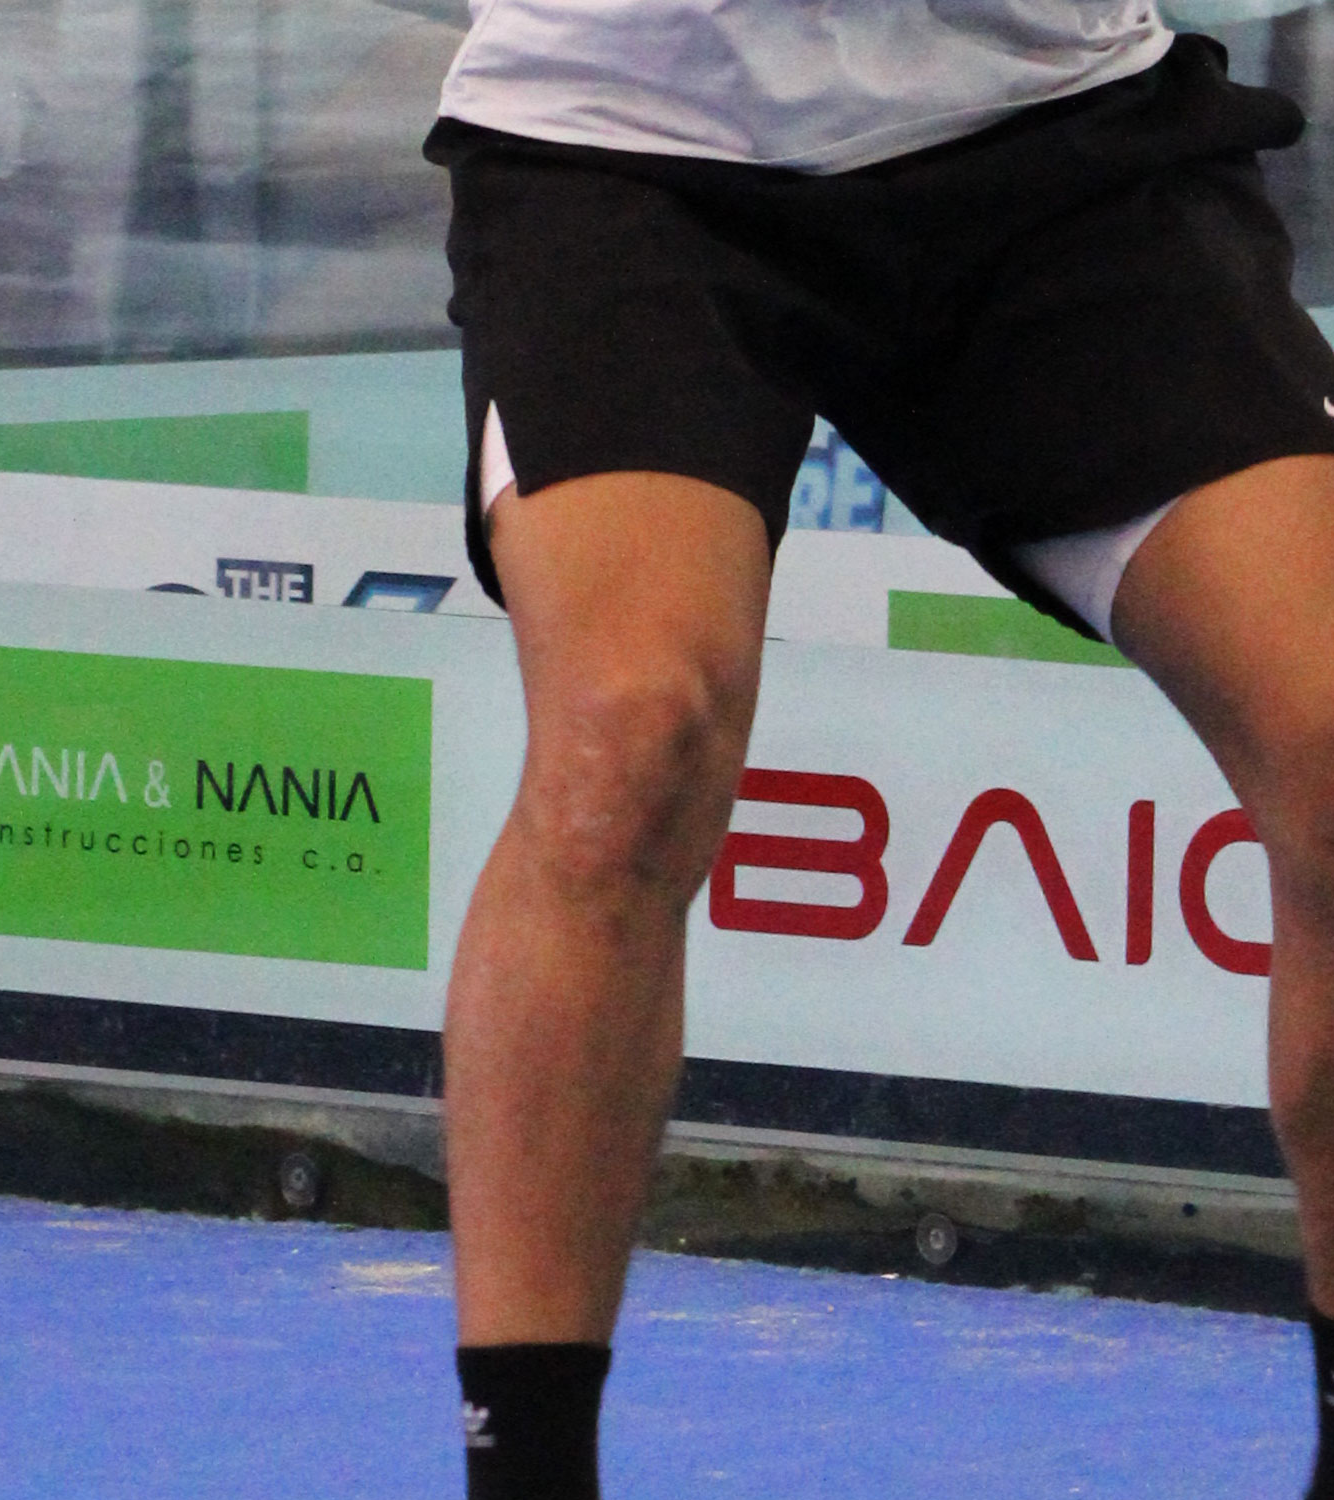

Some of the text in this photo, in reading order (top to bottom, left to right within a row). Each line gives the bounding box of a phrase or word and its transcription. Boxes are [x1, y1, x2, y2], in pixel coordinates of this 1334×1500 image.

[143, 759, 172, 808] &
[196, 759, 381, 824] NANIA
[302, 849, 383, 875] c.a.
